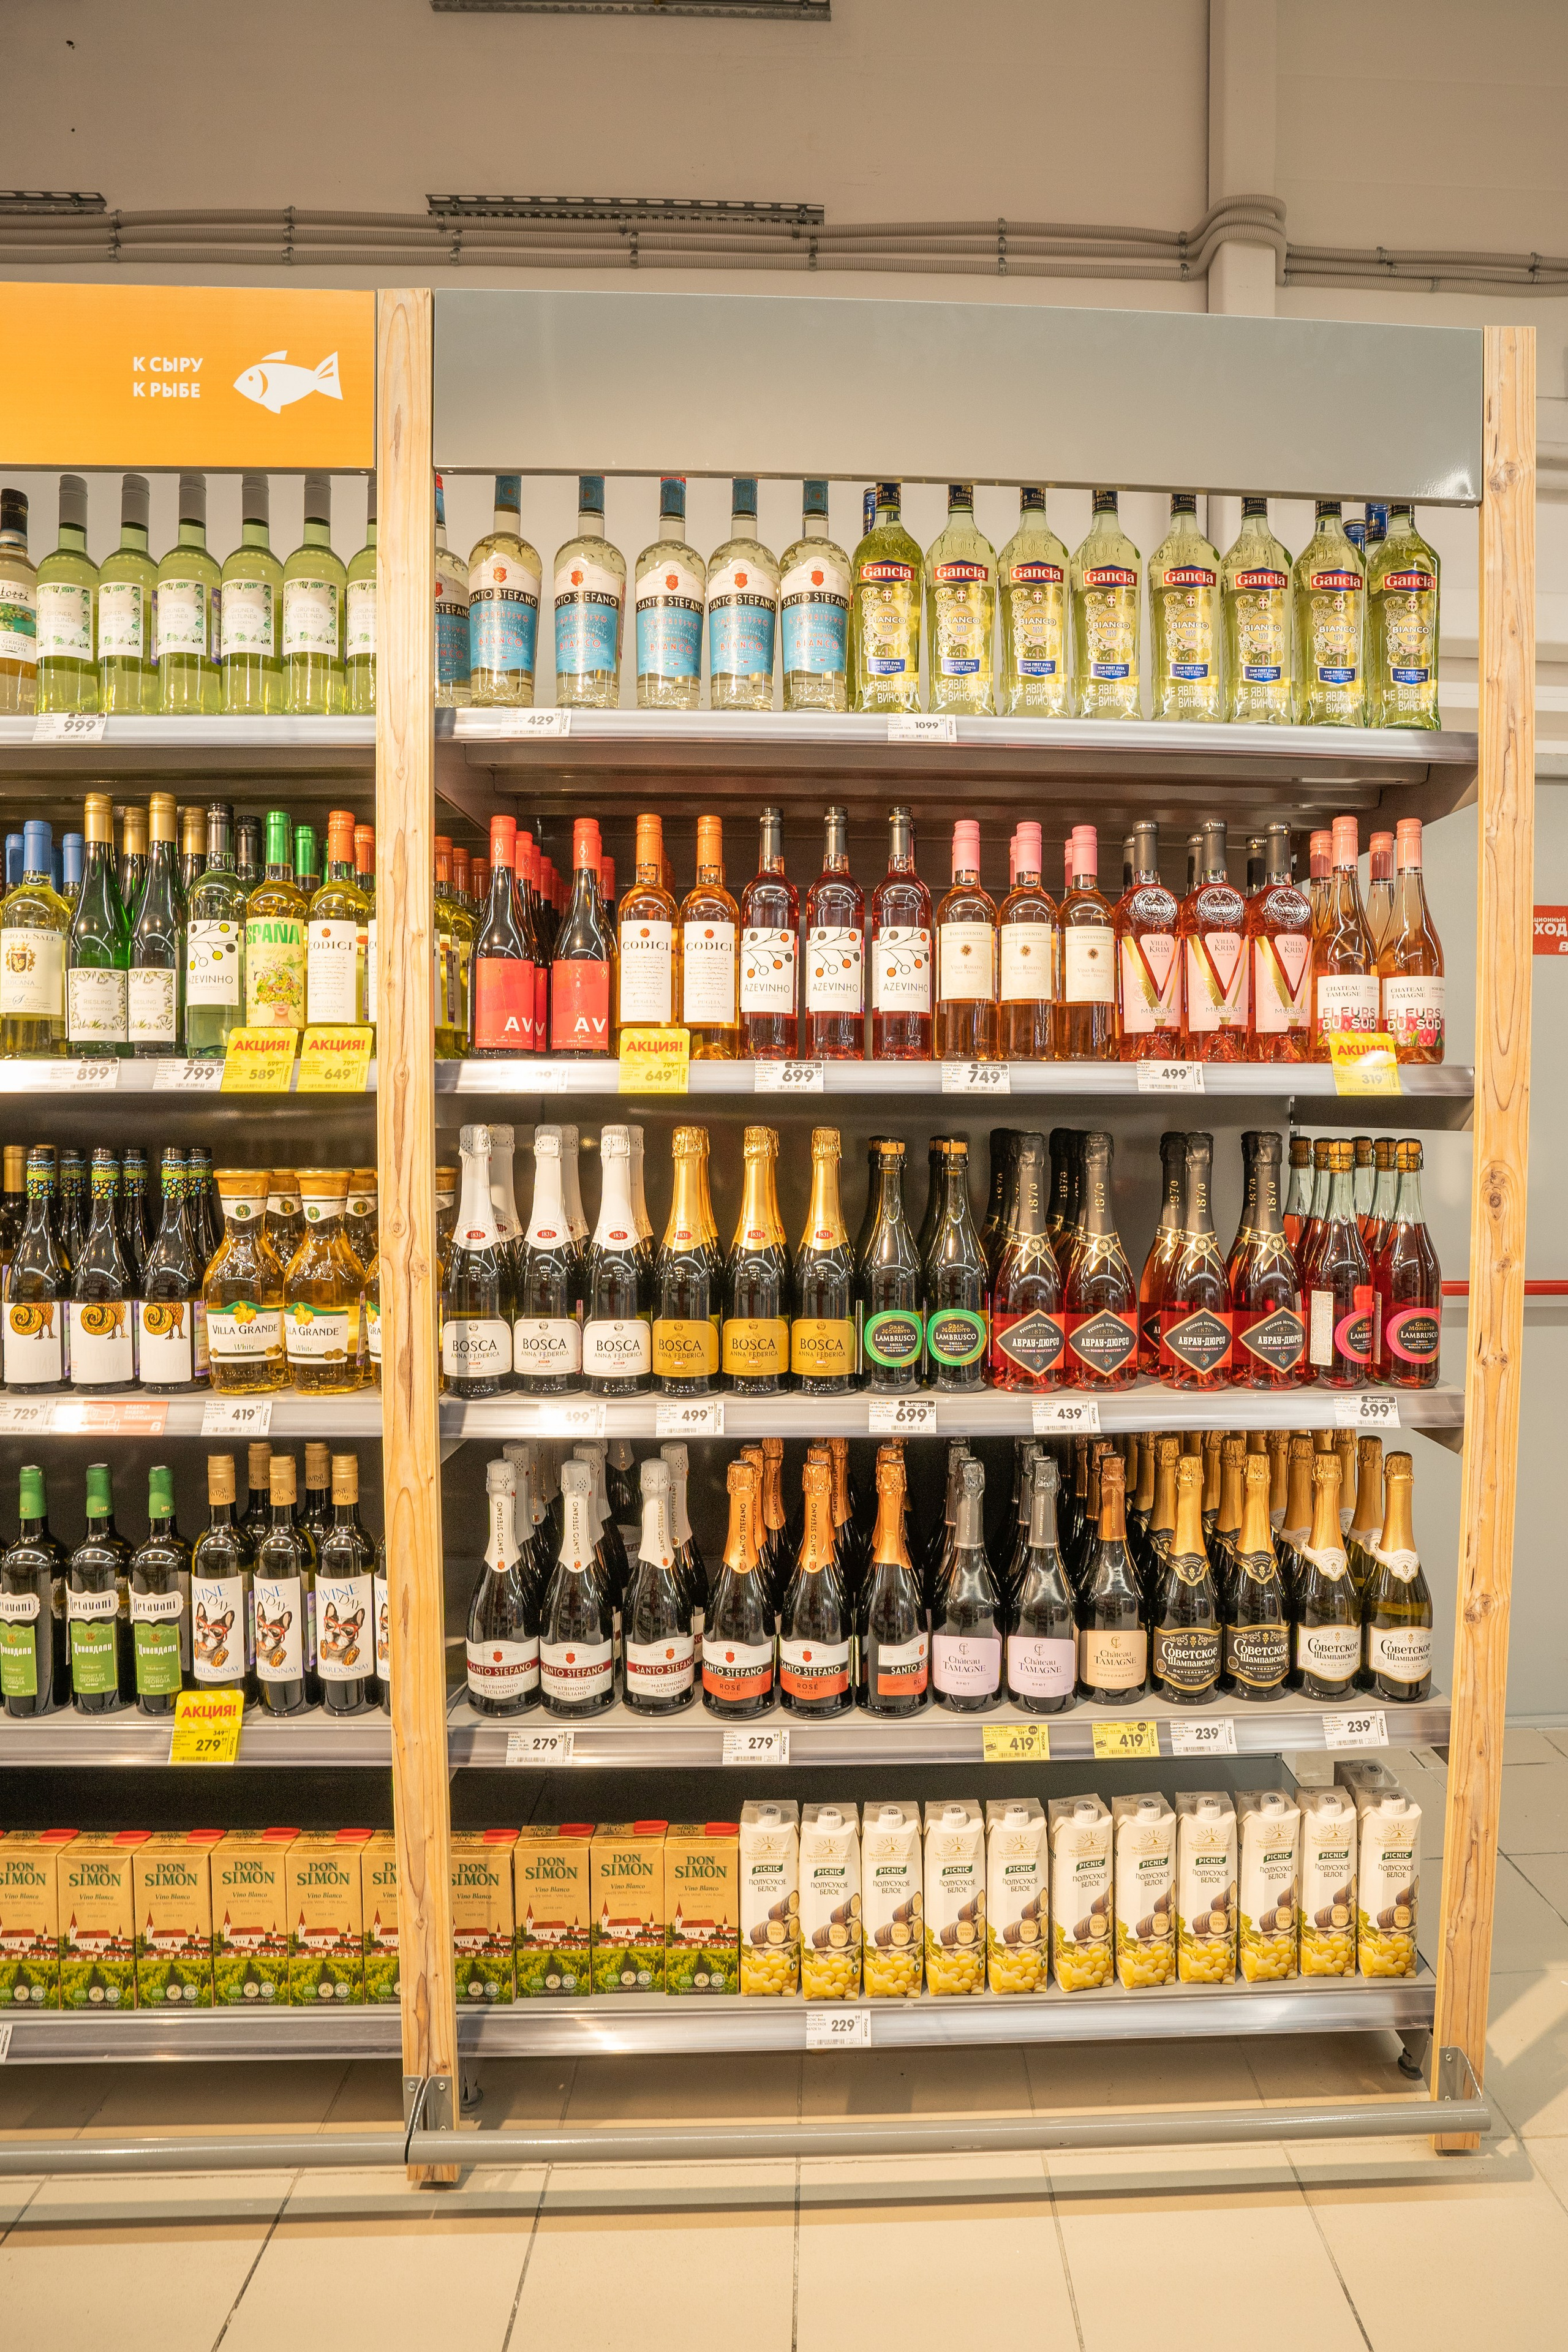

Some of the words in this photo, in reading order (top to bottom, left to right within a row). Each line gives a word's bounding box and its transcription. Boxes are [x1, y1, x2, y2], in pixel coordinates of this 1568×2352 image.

[133, 356, 146, 372] К
[149, 356, 203, 372] СЫРУ
[133, 382, 146, 397] К
[150, 382, 200, 398] РЫБЕ
[862, 565, 912, 578] Gancia
[936, 567, 986, 579] Gancia
[1086, 571, 1135, 583] Gancia
[1165, 571, 1214, 584] Gancia
[1313, 575, 1361, 588] Gancia
[1386, 575, 1434, 588] Gancia
[469, 589, 492, 605] SANTO
[495, 589, 537, 607] STEFANO
[638, 597, 664, 609] SANTO
[668, 597, 704, 614] STEFANO
[2, 638, 28, 647] GRIGIO
[478, 637, 522, 647] BIANCO
[650, 643, 693, 654] BIANCO
[64, 720, 96, 732] 999
[527, 715, 554, 725] 429
[246, 921, 300, 945] SPAÑA
[1534, 922, 1568, 937] ХОД
[33, 933, 56, 942] SALE
[309, 941, 353, 951] CODICI
[622, 941, 669, 951] CODICI
[189, 975, 233, 984] AZEVINHO
[745, 983, 790, 993] AZEVINHO
[1323, 1006, 1376, 1019] FLEURS
[1322, 1018, 1342, 1030] DU
[1351, 1018, 1376, 1030] SUD
[233, 1040, 290, 1053] АКЦИЯ!
[309, 1039, 365, 1052] АКЦИЯ!
[626, 1041, 683, 1055] АКЦИЯ!
[77, 1066, 109, 1080] 899
[183, 1067, 215, 1080] 799
[249, 1069, 276, 1080] 589
[324, 1069, 351, 1080] 649
[645, 1071, 672, 1082] 649
[782, 1069, 814, 1082] 699
[968, 1071, 1000, 1084] 749
[1162, 1068, 1187, 1079] 499
[1362, 1074, 1383, 1084] 319
[1095, 1182, 1104, 1213] 1870
[1197, 1182, 1206, 1213] 1870
[213, 1324, 235, 1335] VILLA
[238, 1322, 278, 1335] GRANDE
[298, 1326, 339, 1336] GRANDE
[453, 1340, 497, 1352] BOSCA
[597, 1339, 641, 1351] BOSCA
[659, 1339, 702, 1351] BOSCA
[13, 1408, 39, 1420] 729
[232, 1409, 255, 1420] 419
[682, 1410, 708, 1421] 499
[895, 1408, 927, 1422] 699
[1057, 1408, 1082, 1419] 439
[1360, 1404, 1389, 1417] 699
[319, 1581, 360, 1601] WINE
[338, 1594, 363, 1611] DAY
[1161, 1641, 1218, 1658] Советское
[1308, 1638, 1358, 1654] Советское
[1100, 1649, 1132, 1658] Château
[1314, 1651, 1356, 1660] Шампанское
[949, 1655, 981, 1665] Château
[1094, 1656, 1137, 1666] TAMAGNE
[1168, 1656, 1216, 1667] Шампанское
[470, 1664, 491, 1676] SANTO
[494, 1662, 532, 1676] STEFANO
[781, 1661, 801, 1675] SANTO
[804, 1665, 840, 1676] STEFANO
[943, 1662, 987, 1673] TAMAGNE
[181, 1705, 236, 1720] АКЦИЯ!
[1347, 1719, 1371, 1733] 239
[1195, 1727, 1219, 1740] 239
[195, 1740, 221, 1751] 279
[532, 1738, 557, 1750] 279
[748, 1737, 773, 1749] 279
[1009, 1736, 1035, 1751] 419
[1119, 1733, 1144, 1747] 419
[612, 1853, 642, 1863] DON
[81, 1863, 110, 1873] DON
[600, 1863, 654, 1877] SIMON
[68, 1873, 121, 1887] SIMON
[748, 1877, 787, 1886] ПОЛУСУХОЕ
[831, 2019, 855, 2032] 229
